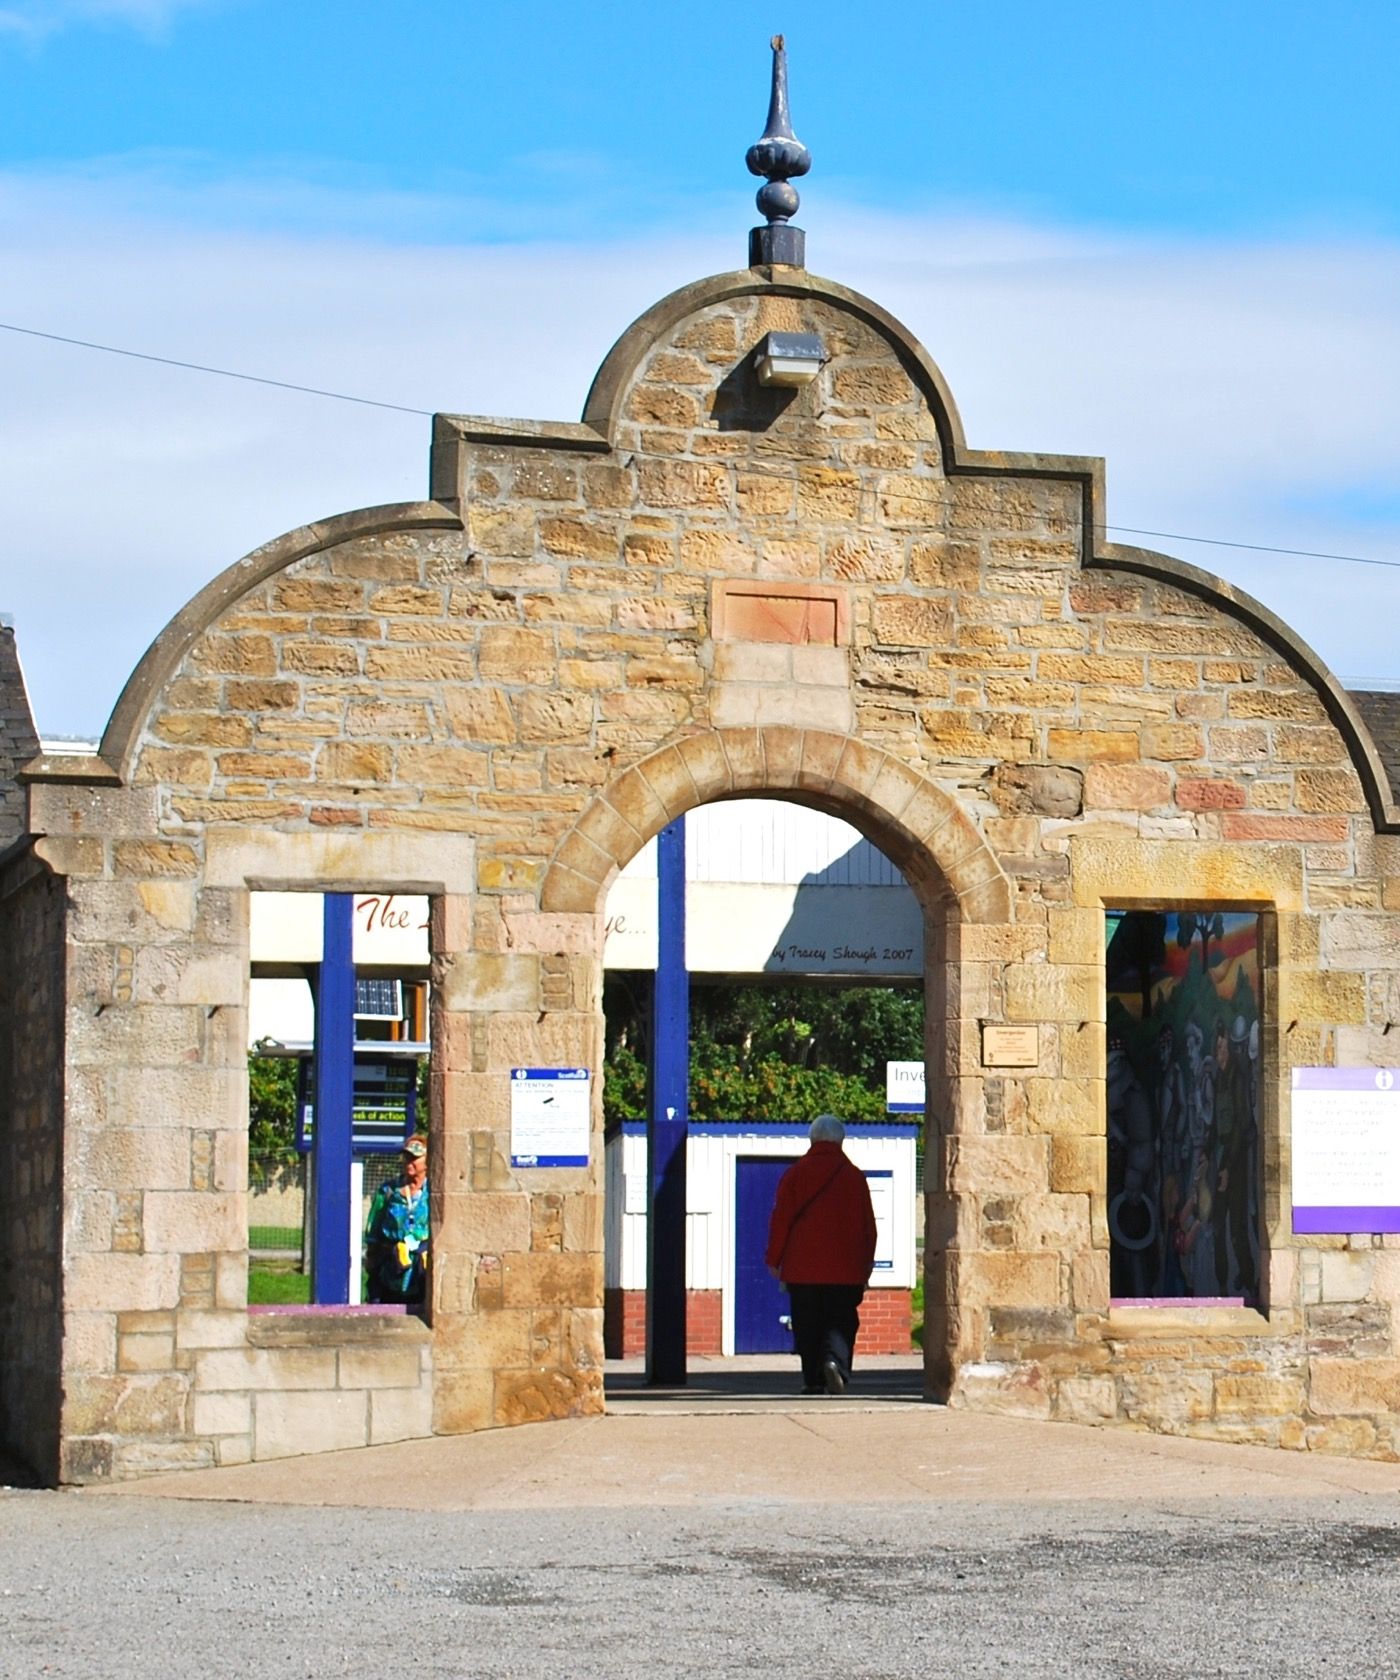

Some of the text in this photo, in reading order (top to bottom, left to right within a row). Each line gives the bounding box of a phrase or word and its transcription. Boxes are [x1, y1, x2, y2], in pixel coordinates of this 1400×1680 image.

[357, 894, 410, 932] The
[883, 948, 913, 960] 2007
[379, 1111, 406, 1121] action
